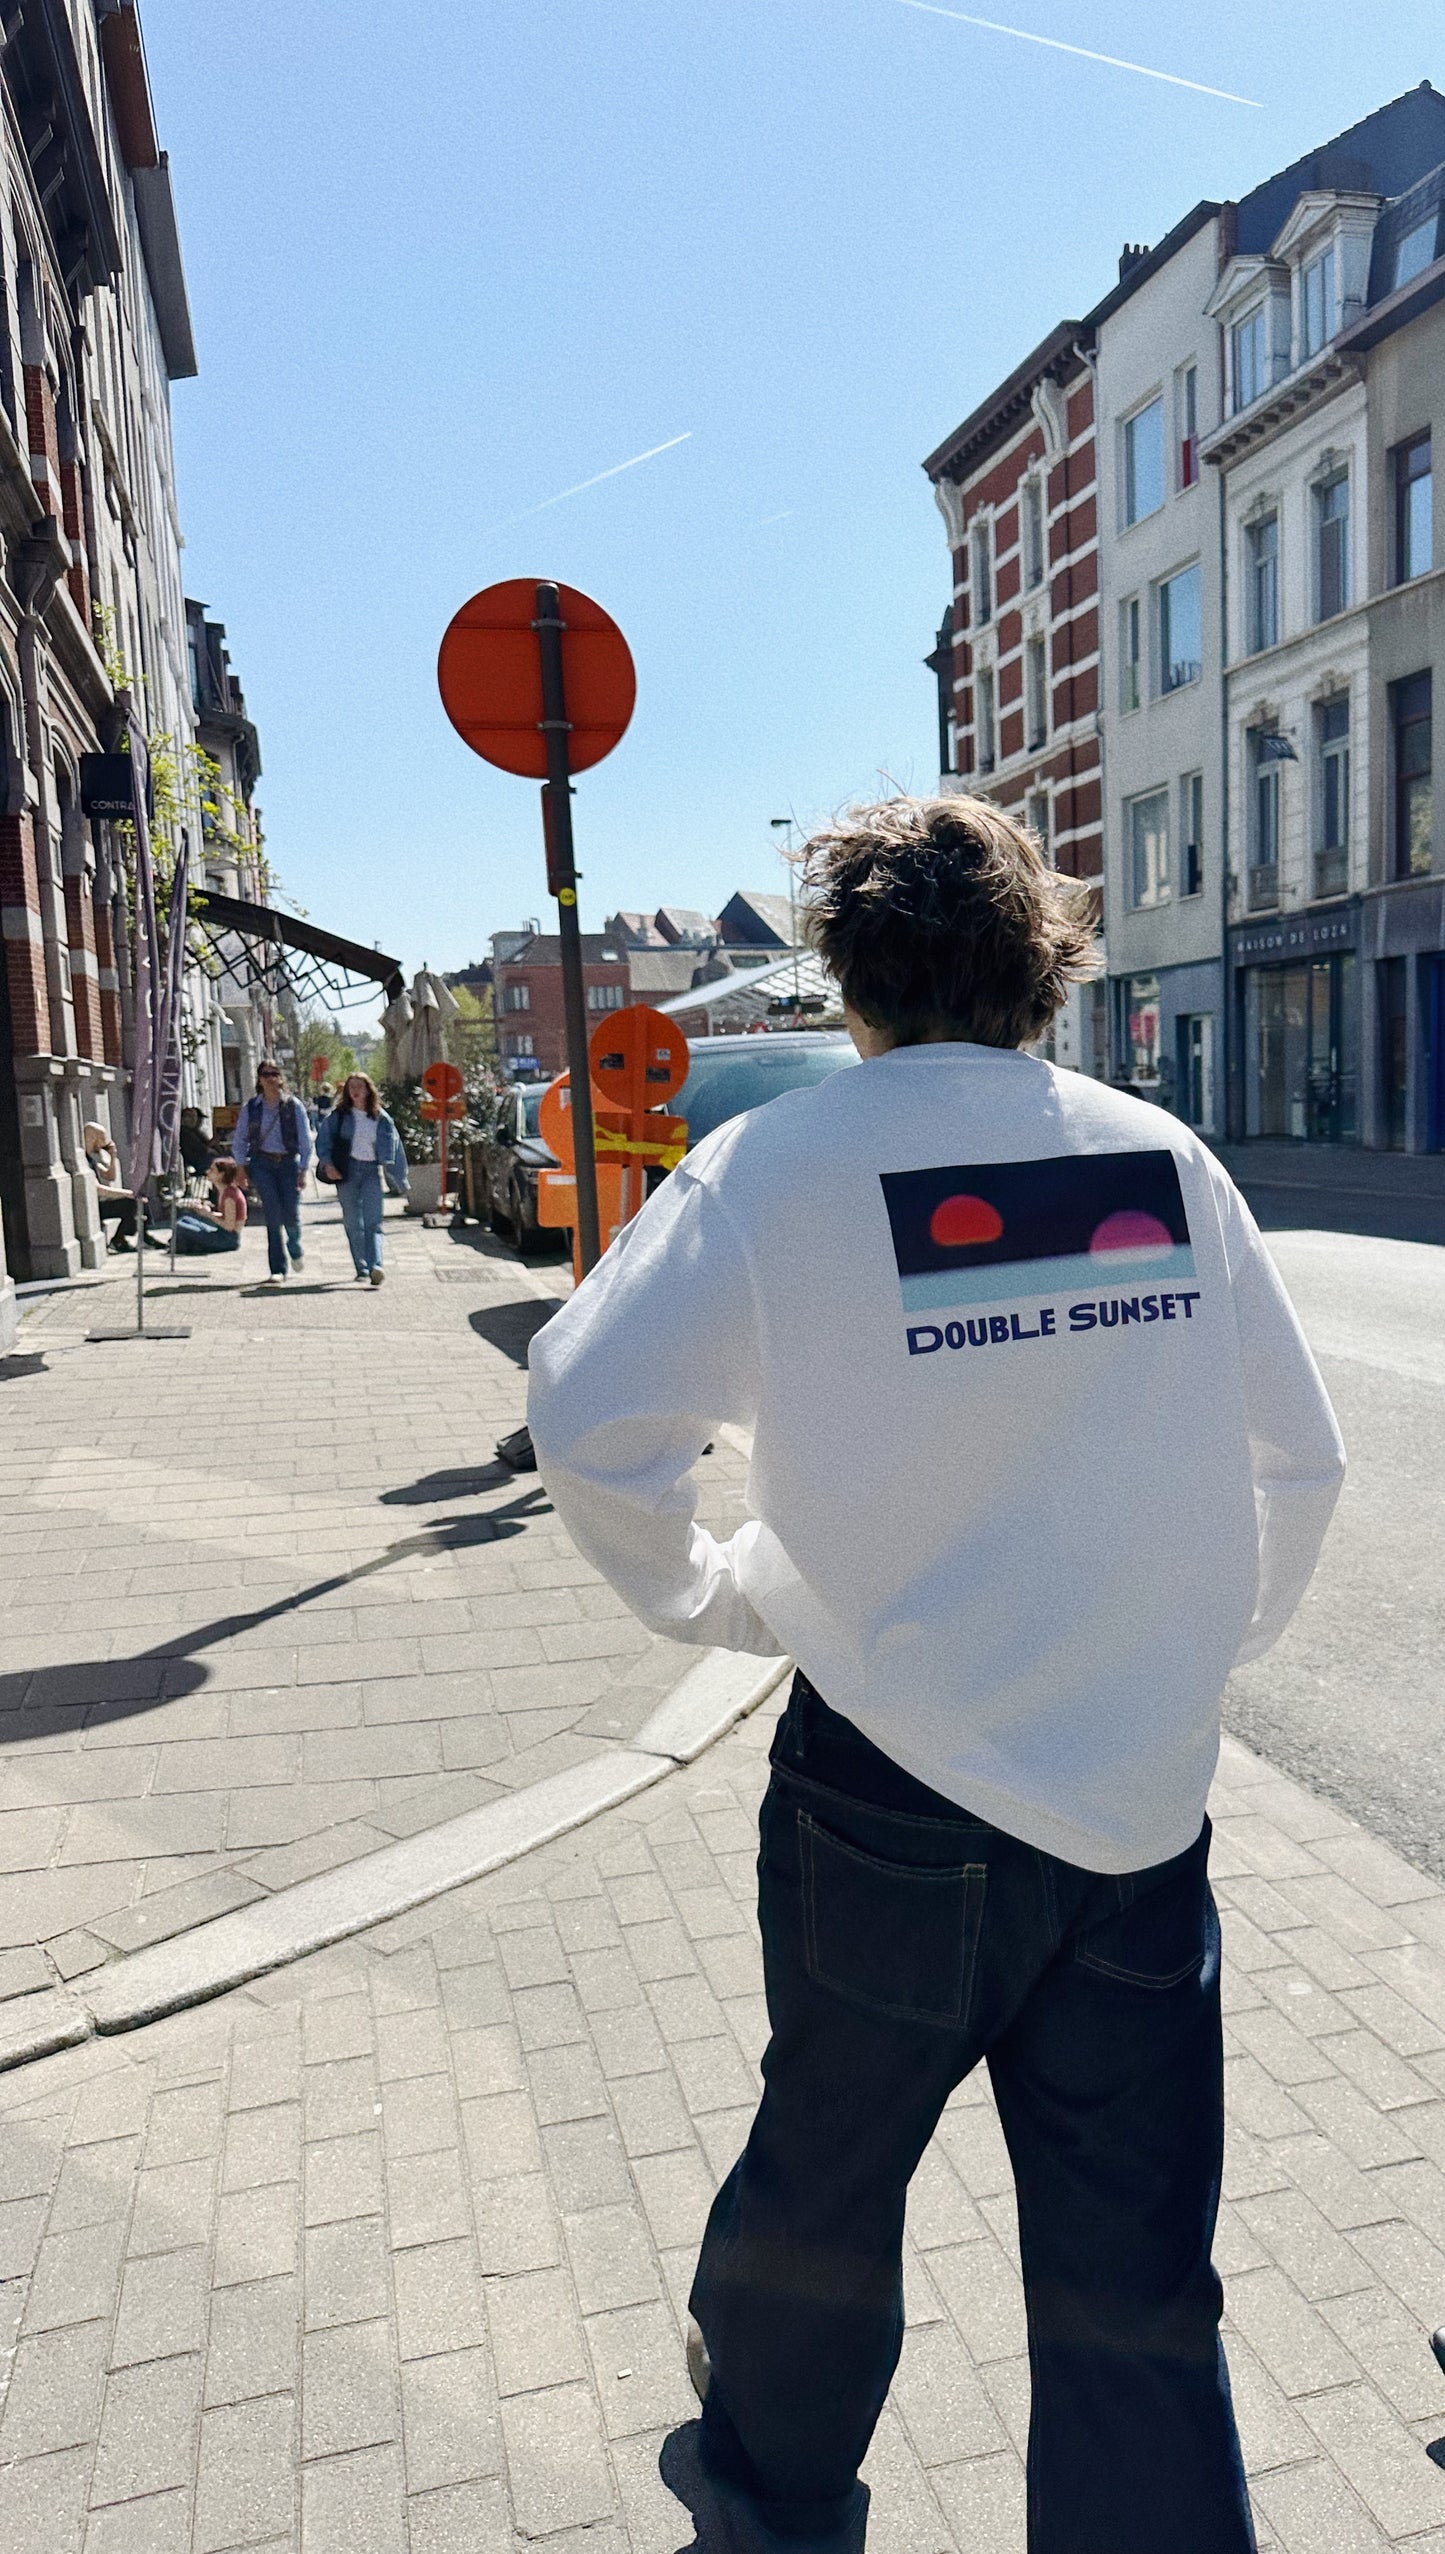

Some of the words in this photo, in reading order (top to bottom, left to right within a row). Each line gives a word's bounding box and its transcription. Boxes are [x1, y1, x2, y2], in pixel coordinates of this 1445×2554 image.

[90, 800, 136, 811] CONTRA
[1289, 931, 1305, 945] DE
[906, 1308, 1056, 1356] DOUBLE
[1068, 1292, 1201, 1332] SUNSET
